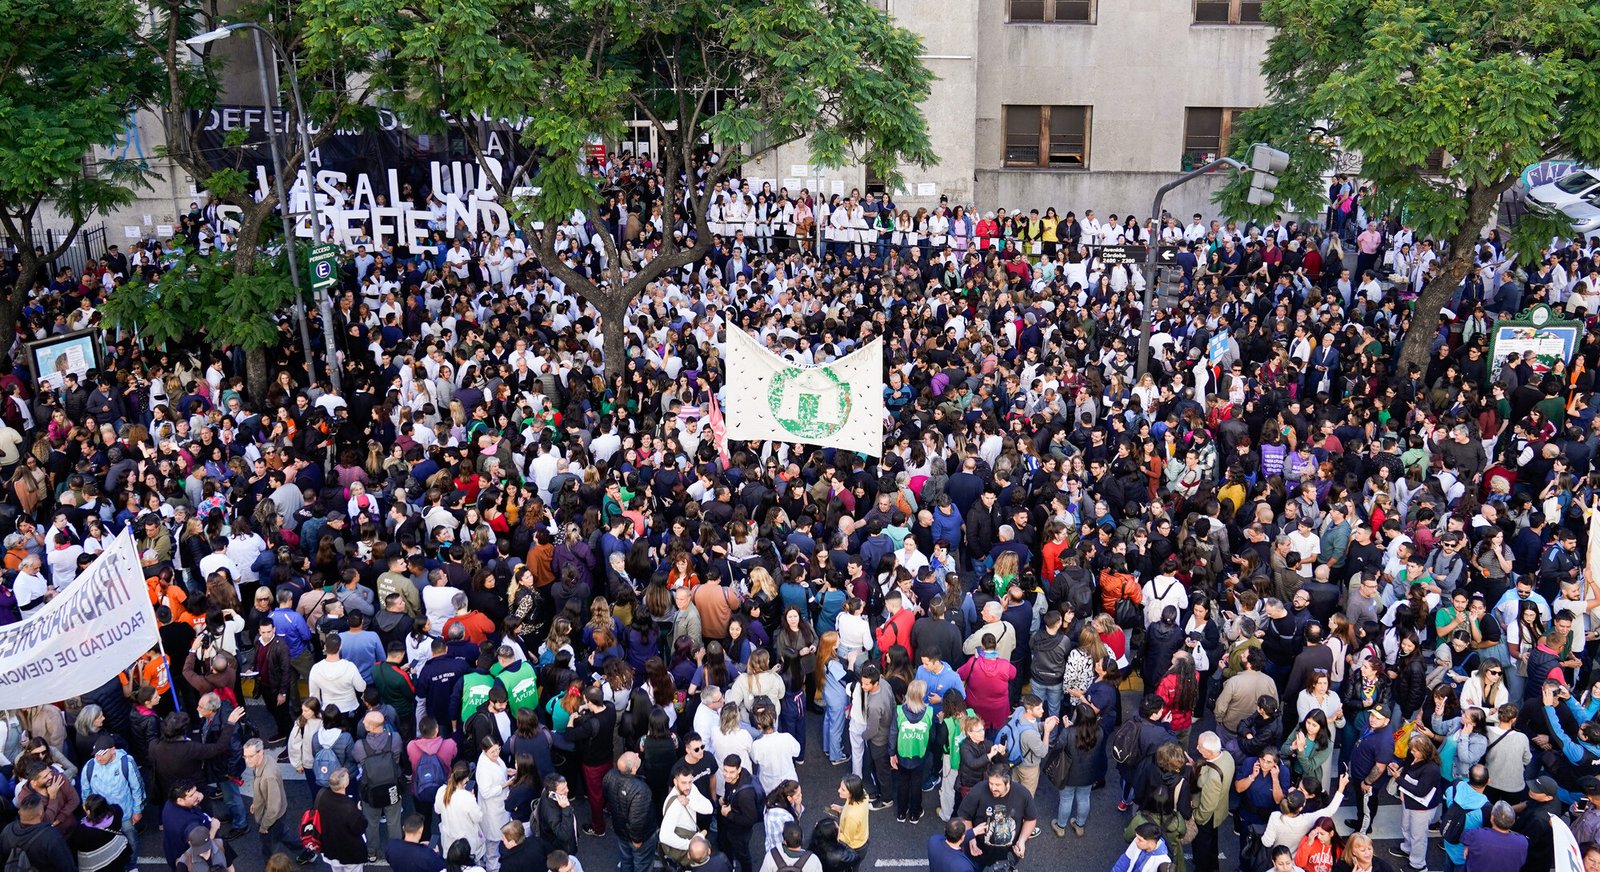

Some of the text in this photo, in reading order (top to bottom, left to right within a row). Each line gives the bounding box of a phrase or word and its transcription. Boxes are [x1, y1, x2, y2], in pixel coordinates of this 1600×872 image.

[312, 246, 331, 254] ACCESO
[309, 252, 334, 262] PERMITIDO
[319, 263, 328, 276] E
